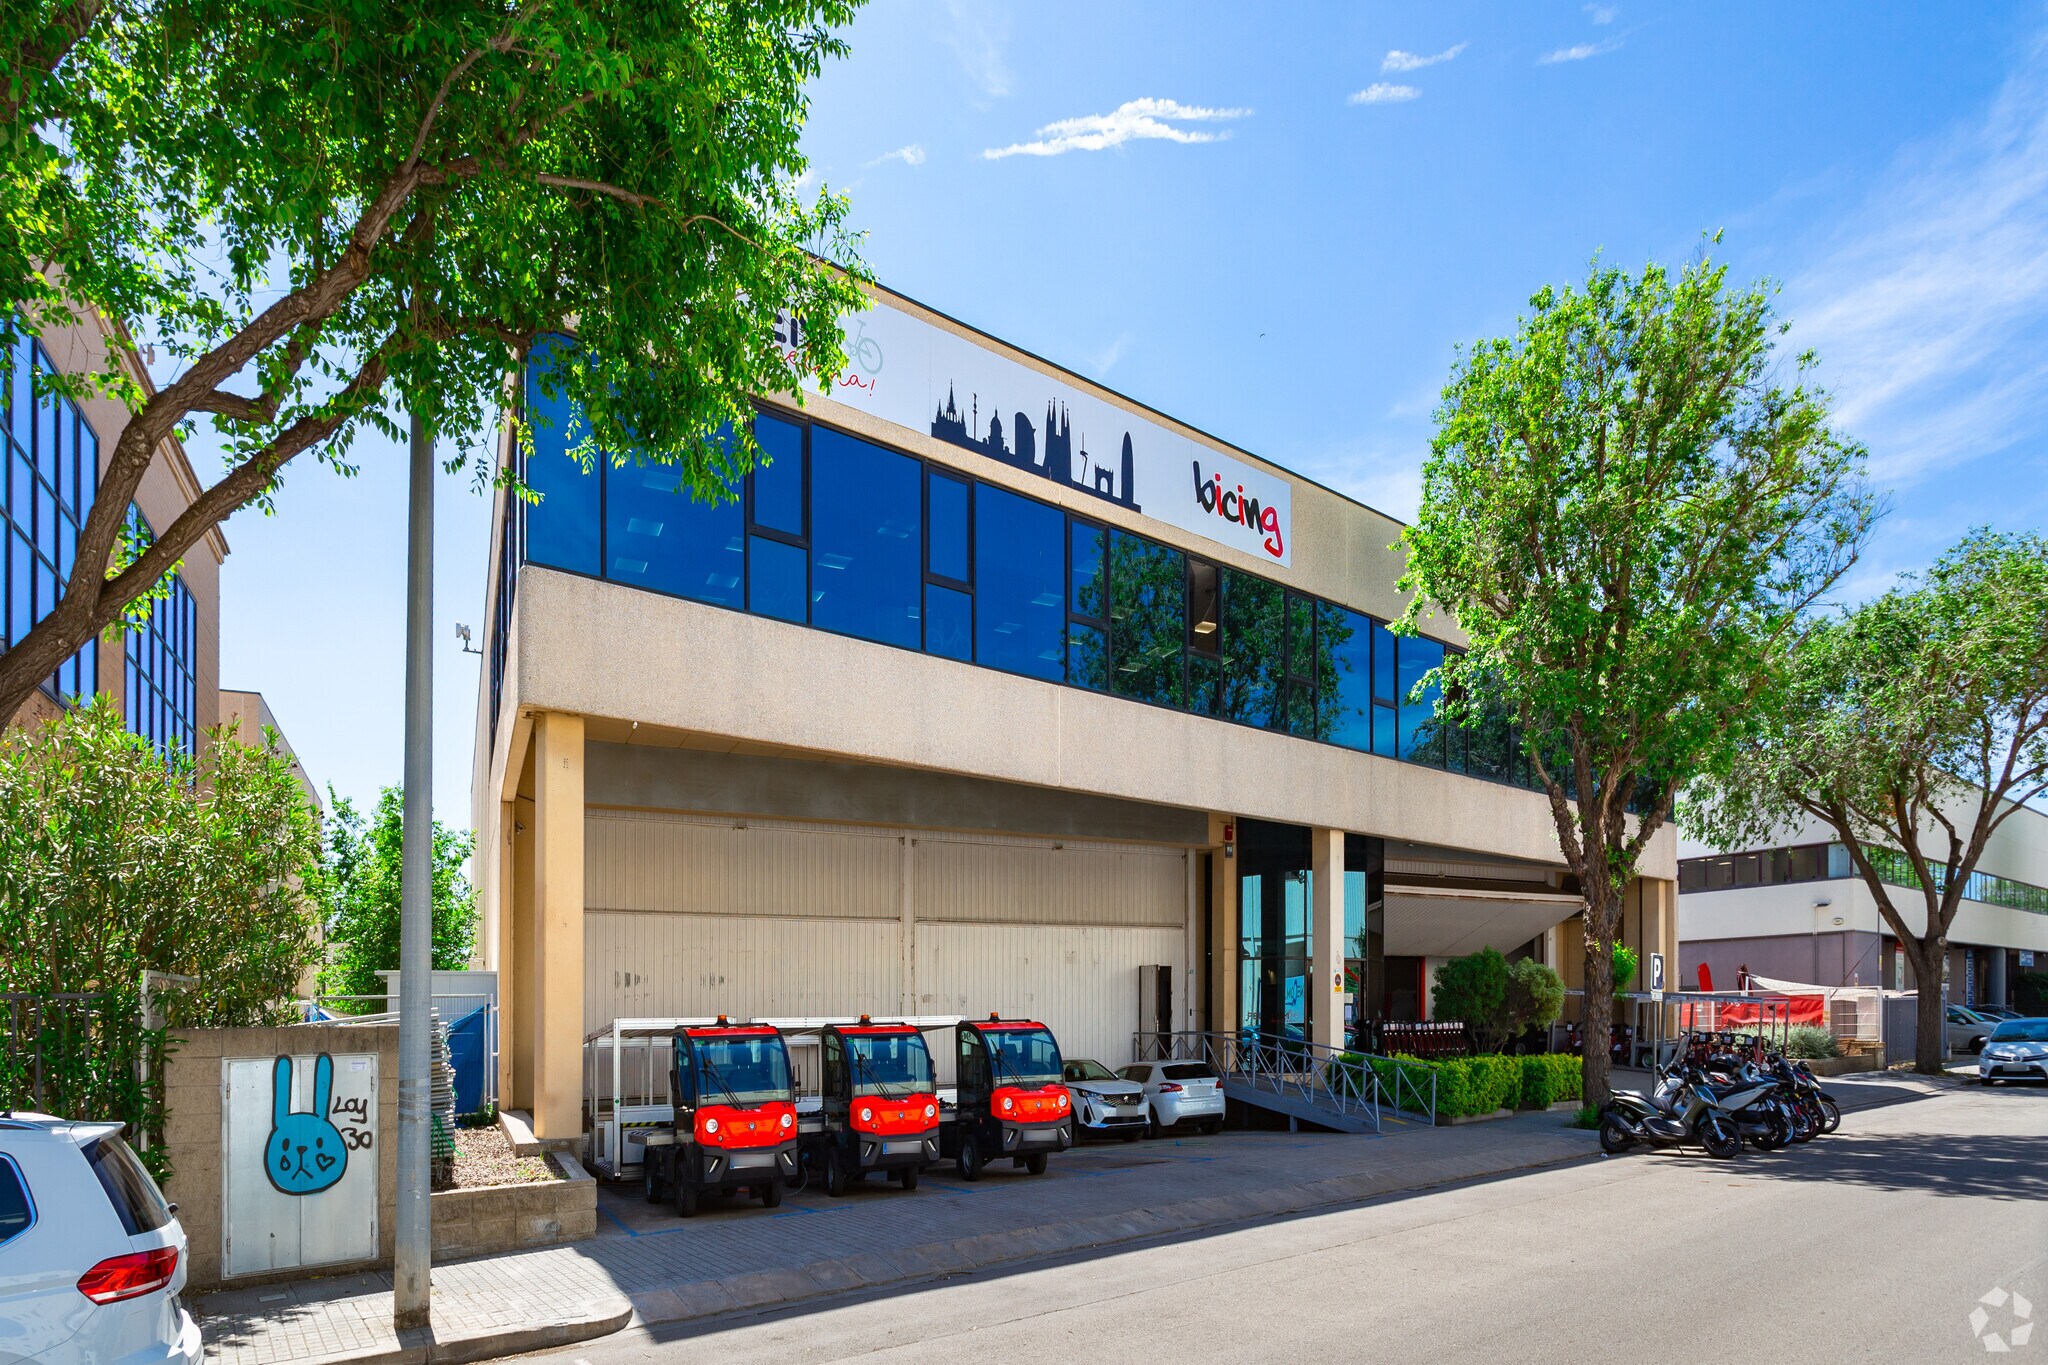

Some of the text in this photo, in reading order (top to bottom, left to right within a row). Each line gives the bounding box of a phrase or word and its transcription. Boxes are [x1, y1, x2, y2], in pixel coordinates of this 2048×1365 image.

[1193, 460, 1283, 558] bicing
[1653, 957, 1662, 987] P
[340, 1127, 373, 1150] 30
